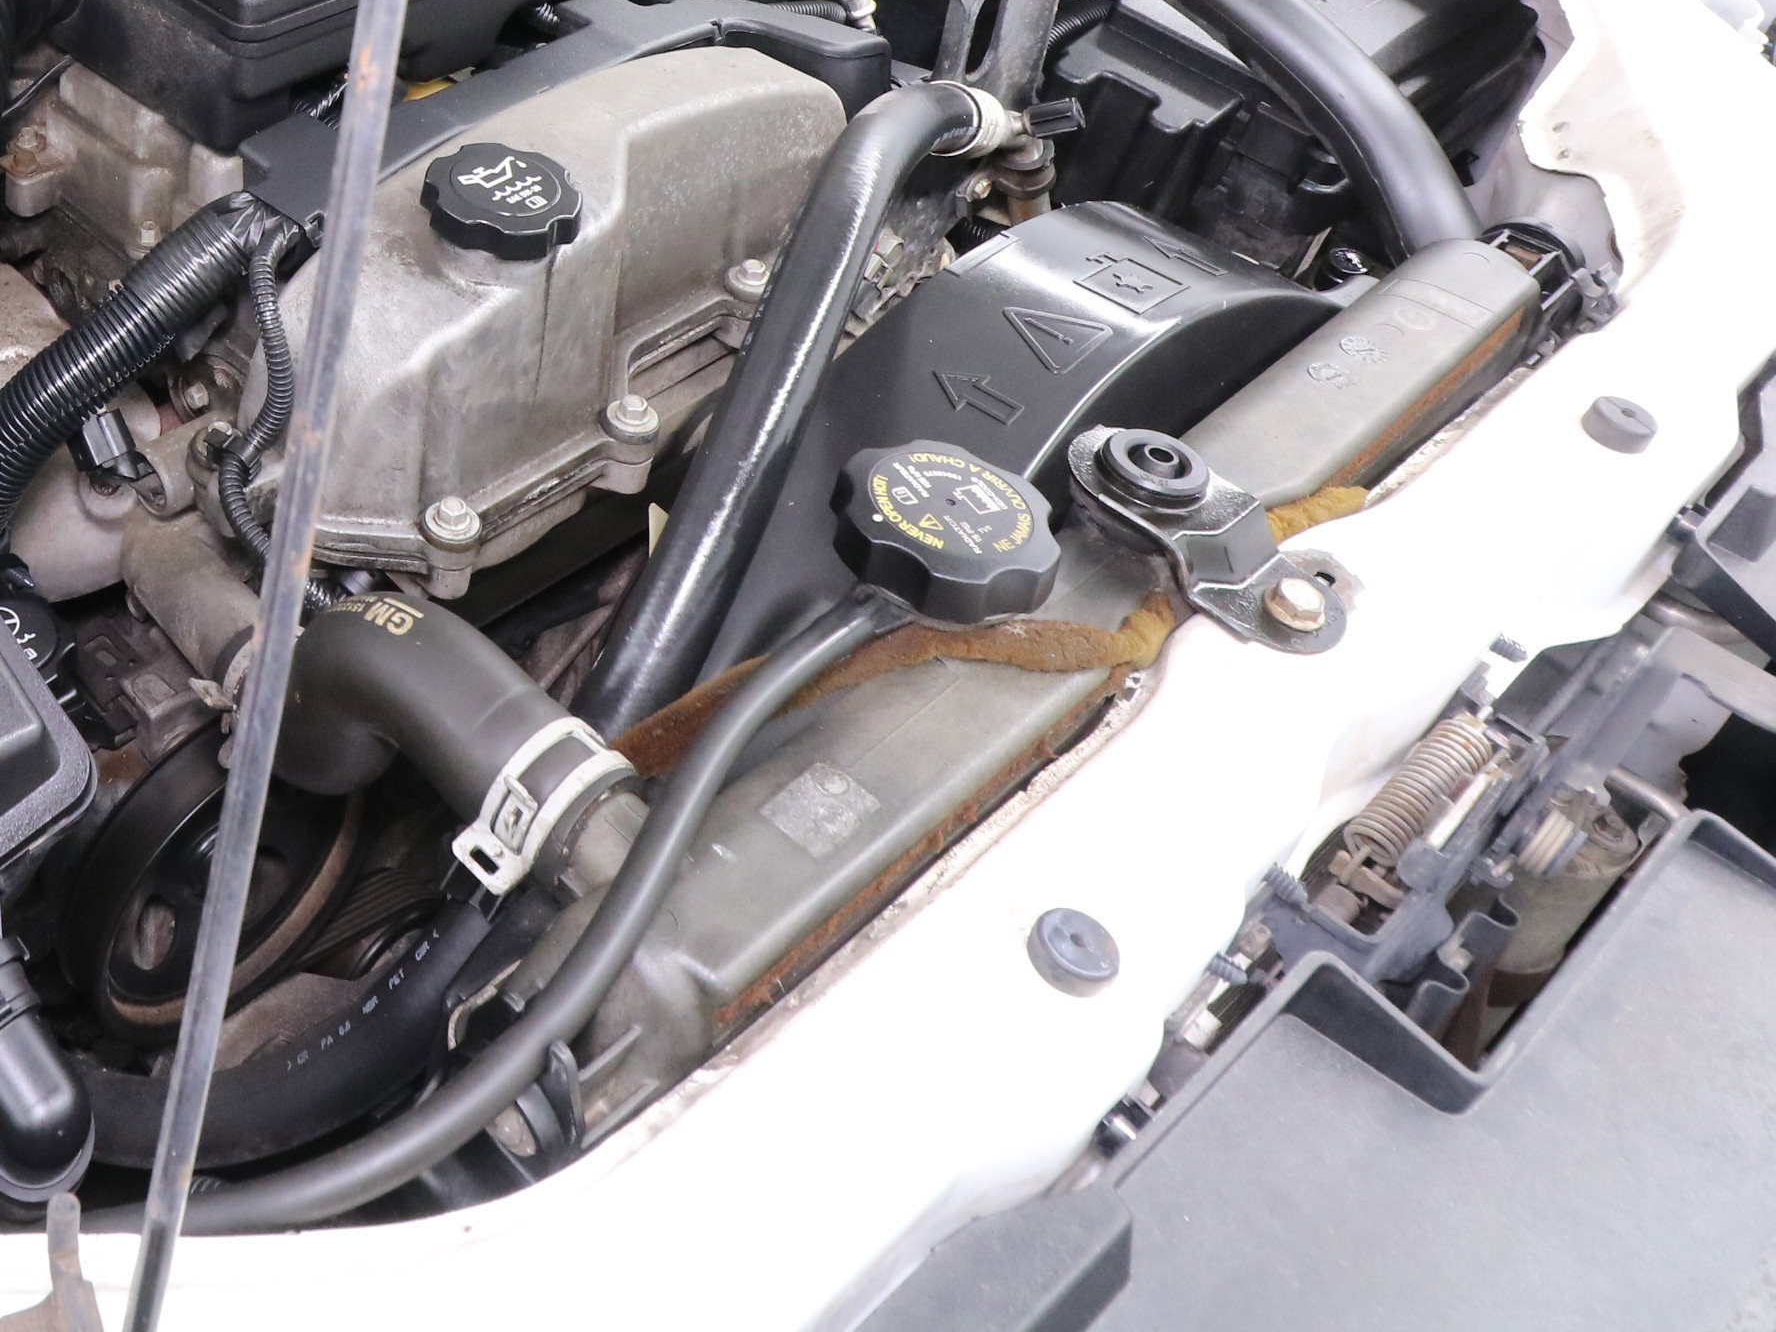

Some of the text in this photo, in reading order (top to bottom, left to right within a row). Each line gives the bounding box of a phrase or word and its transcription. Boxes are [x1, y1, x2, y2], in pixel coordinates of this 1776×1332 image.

[982, 471, 1026, 510] OUVRIR
[876, 496, 902, 522] OPEN
[898, 520, 944, 549] NEVER
[944, 515, 983, 554] RADIATOR
[363, 601, 414, 636] GM
[320, 1034, 334, 1050] PA
